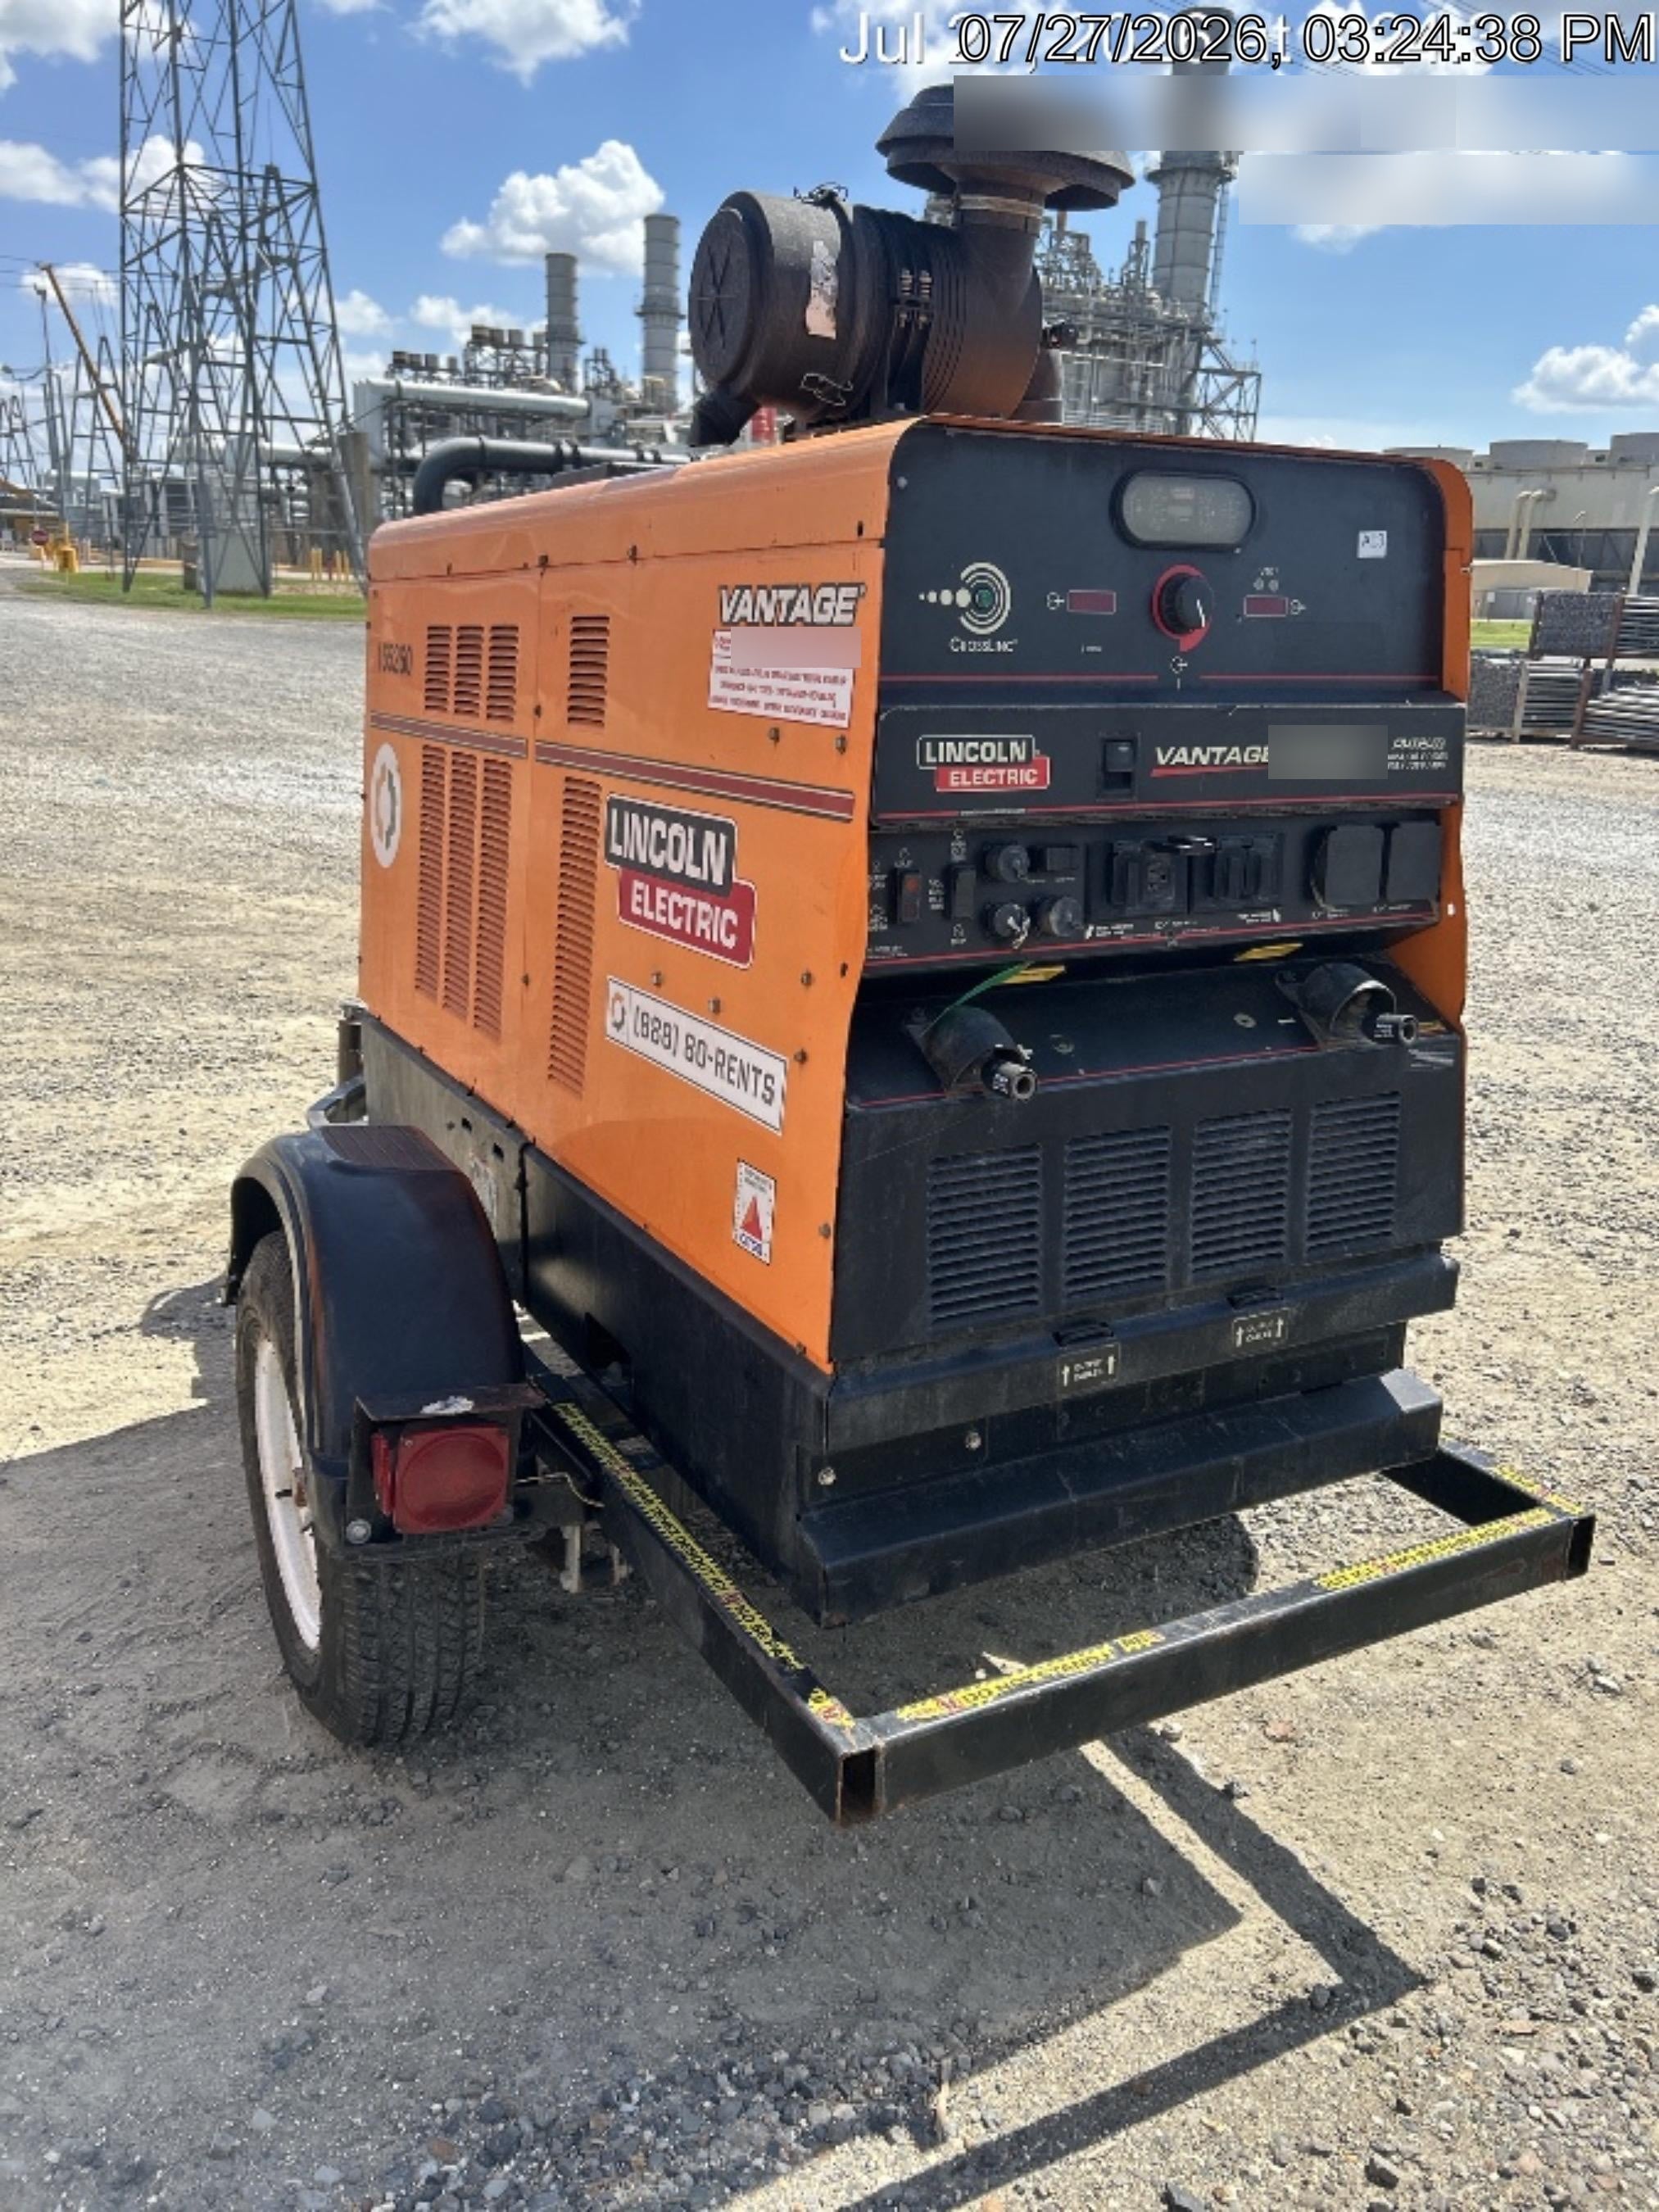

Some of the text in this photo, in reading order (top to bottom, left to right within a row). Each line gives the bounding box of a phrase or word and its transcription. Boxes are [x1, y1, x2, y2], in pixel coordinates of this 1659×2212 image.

[720, 585, 859, 625] VANTAGE
[925, 741, 1027, 764] LINCOLN
[950, 768, 1039, 786] ELECTRIC
[609, 808, 727, 886] LINCOLN
[630, 879, 738, 950] ELECTRIC
[684, 1034, 775, 1107] 80-RENTS
